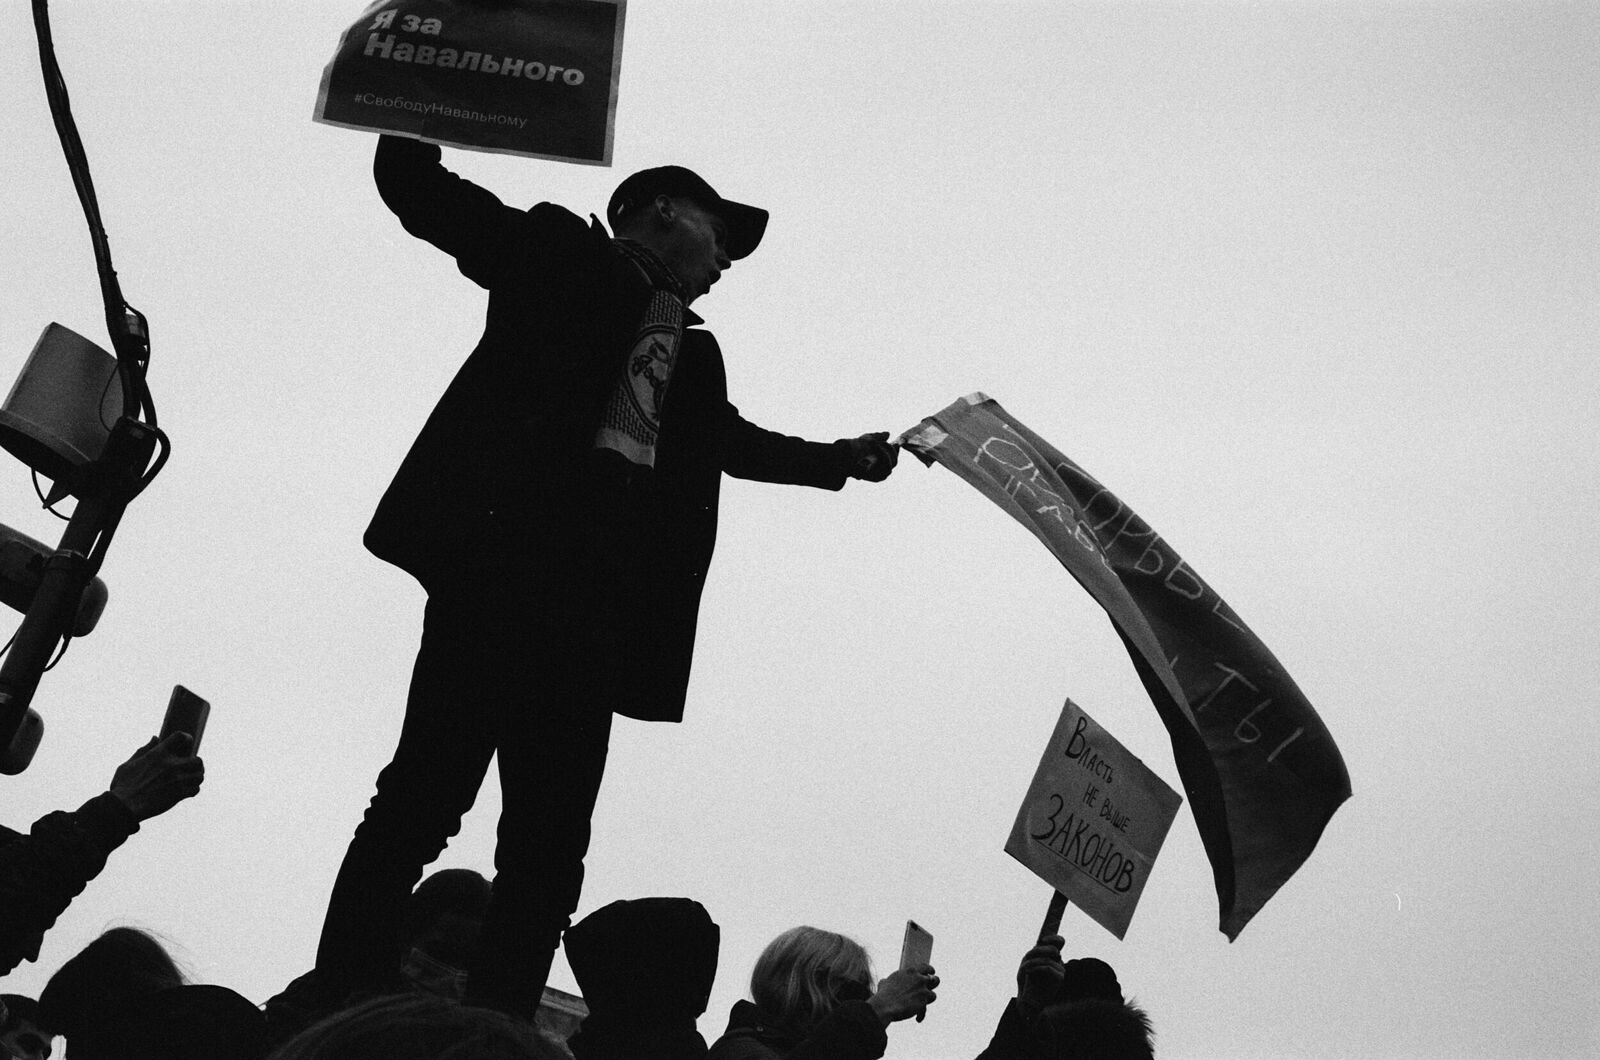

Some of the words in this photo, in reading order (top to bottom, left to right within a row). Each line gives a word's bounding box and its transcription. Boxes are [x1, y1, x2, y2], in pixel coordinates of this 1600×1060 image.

[368, 8, 398, 31] Я
[401, 14, 442, 36] за
[363, 32, 585, 86] Навального
[354, 92, 528, 129] #СвободуНавальному
[1082, 782, 1099, 808] НЕ
[1099, 798, 1130, 833] ВЫШЕ
[1030, 794, 1135, 893] ЗАКОНОВ
